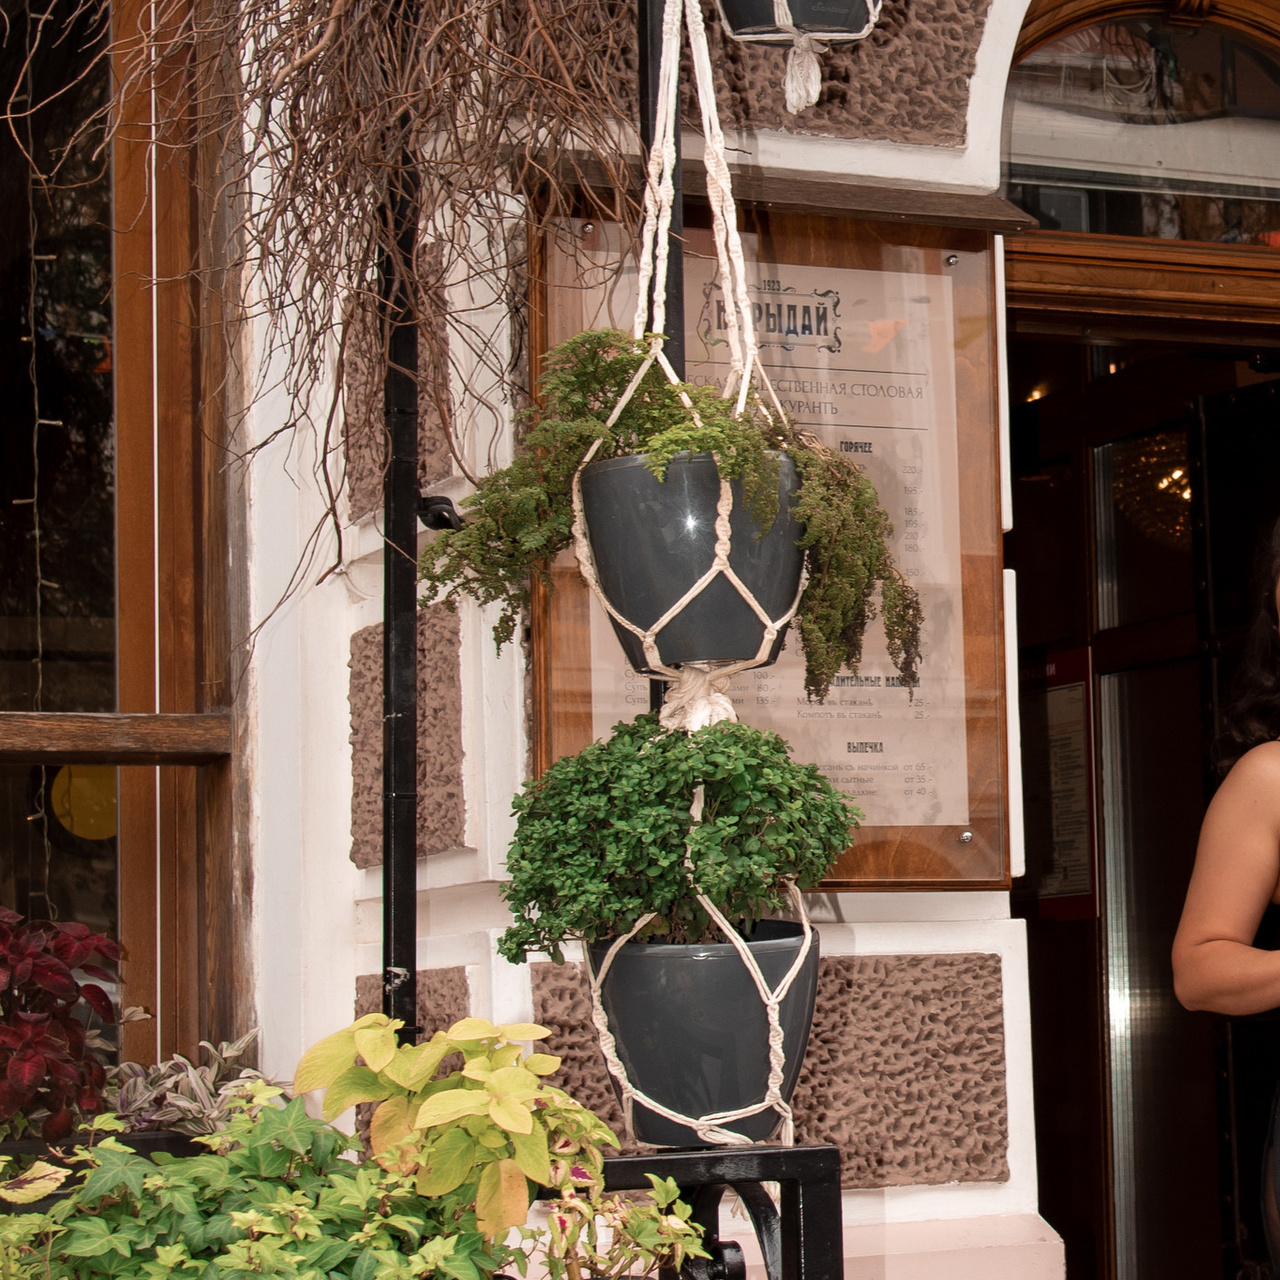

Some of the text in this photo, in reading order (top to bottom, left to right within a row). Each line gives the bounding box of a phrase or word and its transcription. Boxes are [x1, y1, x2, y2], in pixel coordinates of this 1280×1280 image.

[763, 280, 781, 291] 1923
[752, 302, 829, 337] РЫДАЙ
[850, 382, 924, 399] СТОЛОВАЯ
[840, 441, 873, 453] ГОРЯЧЕЕ
[625, 682, 648, 693] Супъ
[625, 695, 648, 706] Супъ
[797, 710, 834, 719] Компотъ
[847, 742, 884, 753] ВЫПЕЧКА
